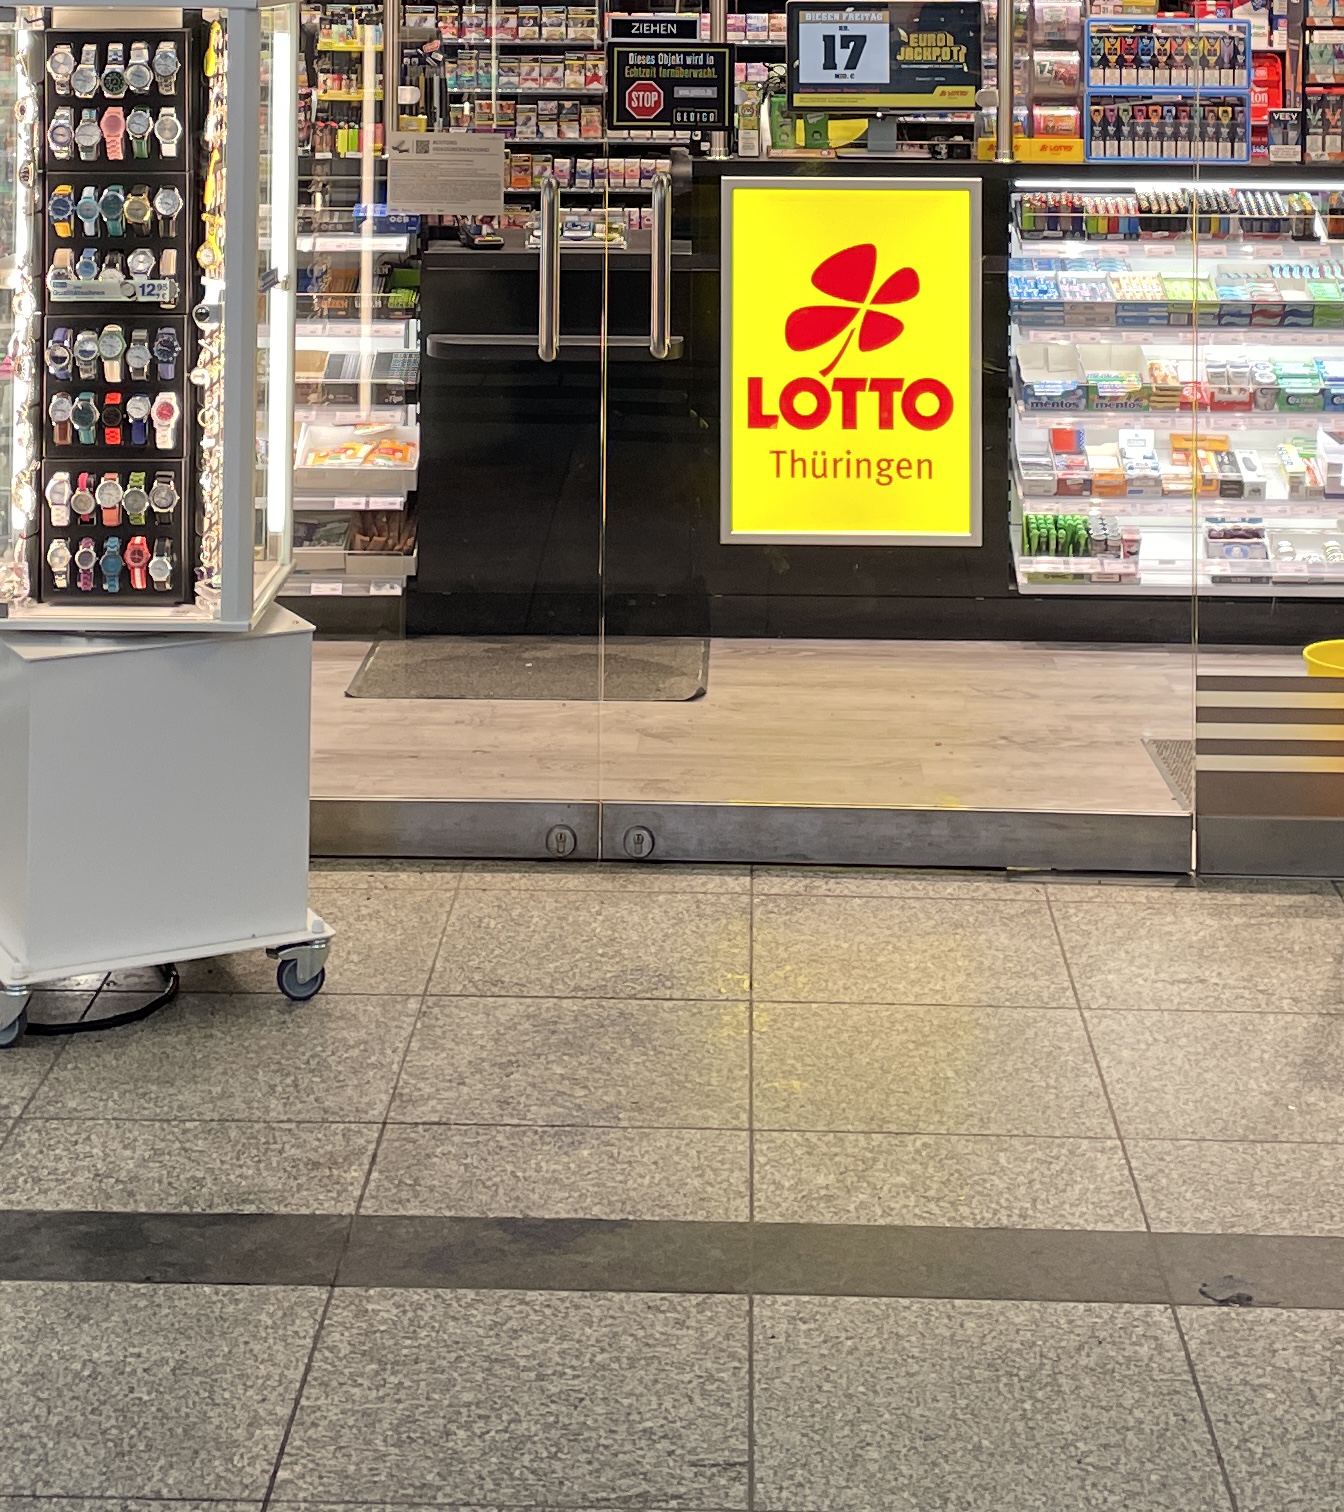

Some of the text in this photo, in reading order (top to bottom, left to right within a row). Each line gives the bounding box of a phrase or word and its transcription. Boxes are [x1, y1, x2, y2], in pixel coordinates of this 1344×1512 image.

[805, 13, 883, 21] DIESEN FREITAG
[631, 22, 677, 34] ZIEHEN
[909, 32, 948, 47] EURO
[822, 34, 867, 71] 17
[896, 46, 962, 62] JACKPOT
[628, 52, 715, 66] Dieses Objekt wird in
[624, 66, 718, 79] Echtzeit fernüberwacht.
[631, 91, 658, 108] STOP
[1272, 112, 1298, 121] VEEV
[1029, 399, 1079, 409] mentos
[1094, 399, 1143, 409] mentos
[1286, 394, 1315, 406] Extra
